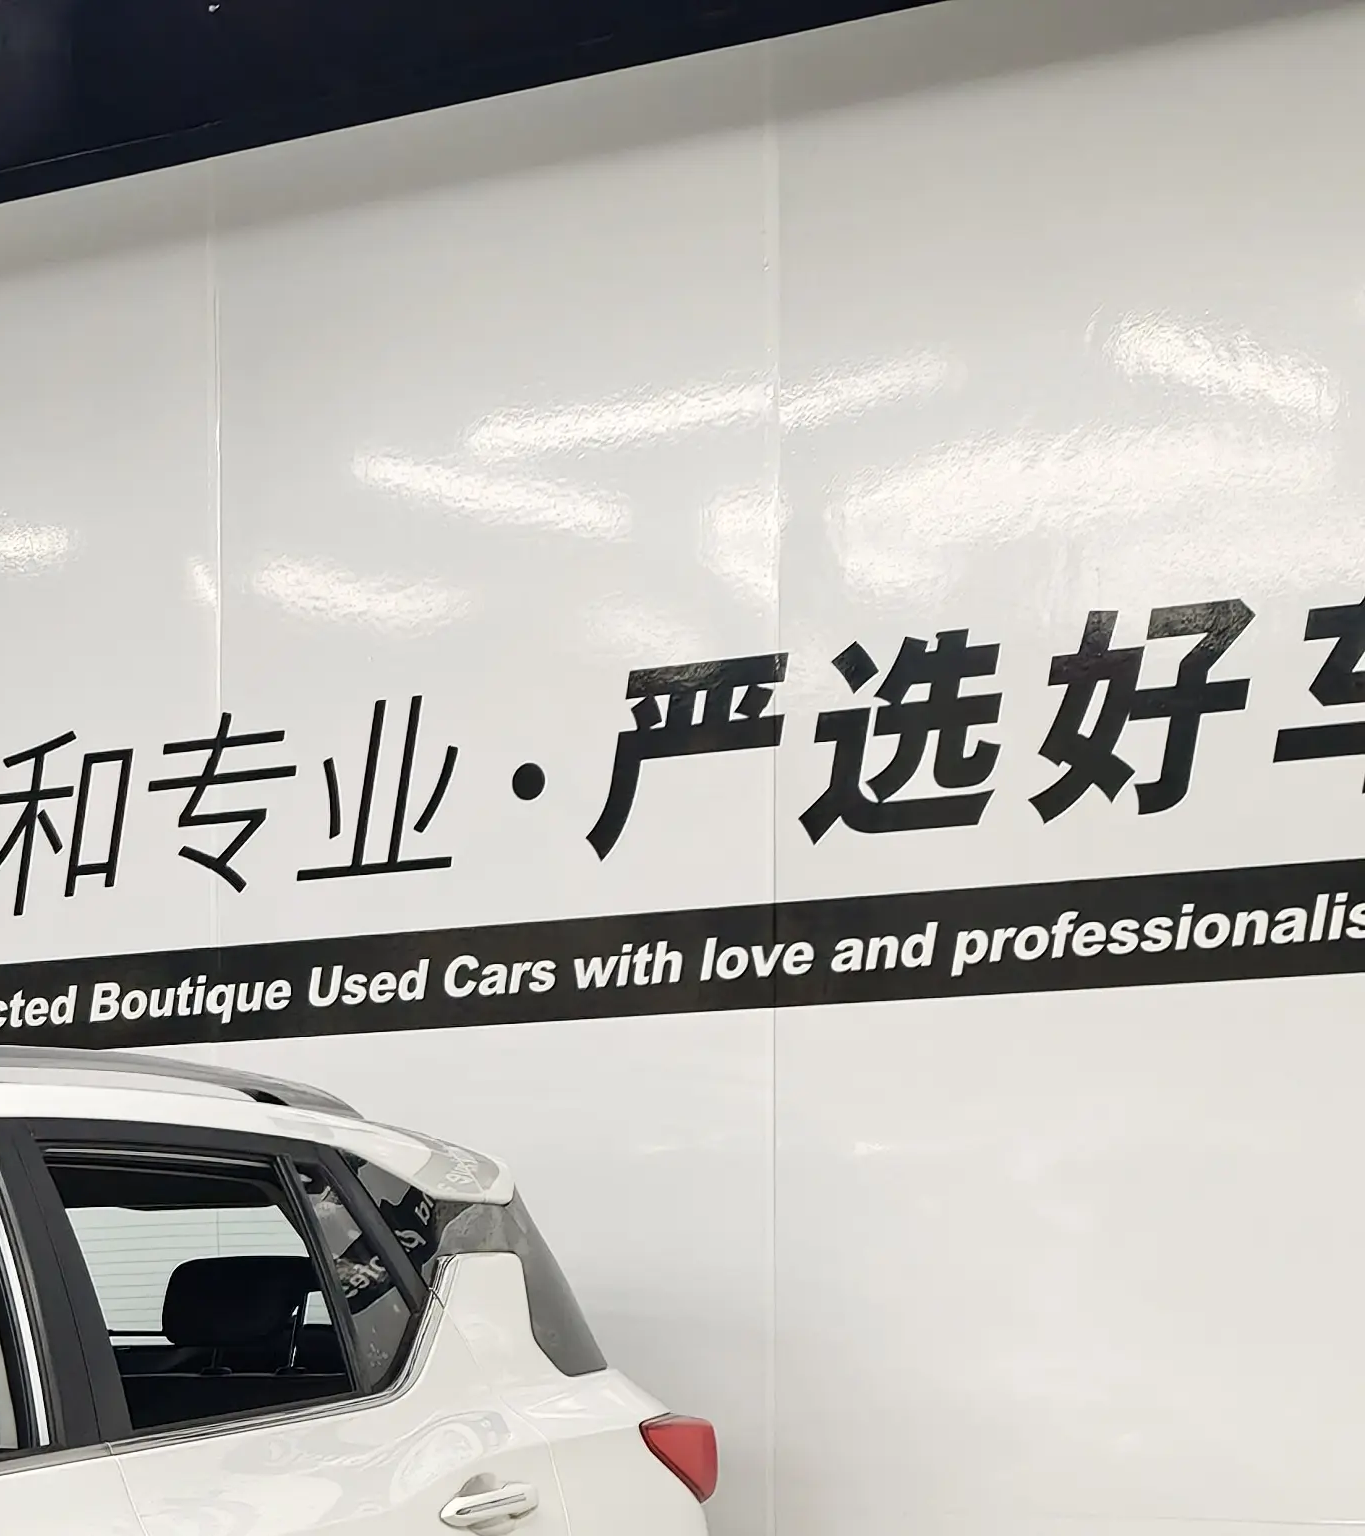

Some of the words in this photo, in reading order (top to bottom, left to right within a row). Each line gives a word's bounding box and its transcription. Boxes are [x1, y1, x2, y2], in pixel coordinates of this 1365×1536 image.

[89, 974, 292, 1024] Boutique
[308, 959, 430, 1007] Used
[443, 954, 557, 998] Cars
[573, 941, 683, 990] with
[699, 937, 815, 982] love
[830, 922, 939, 973] and
